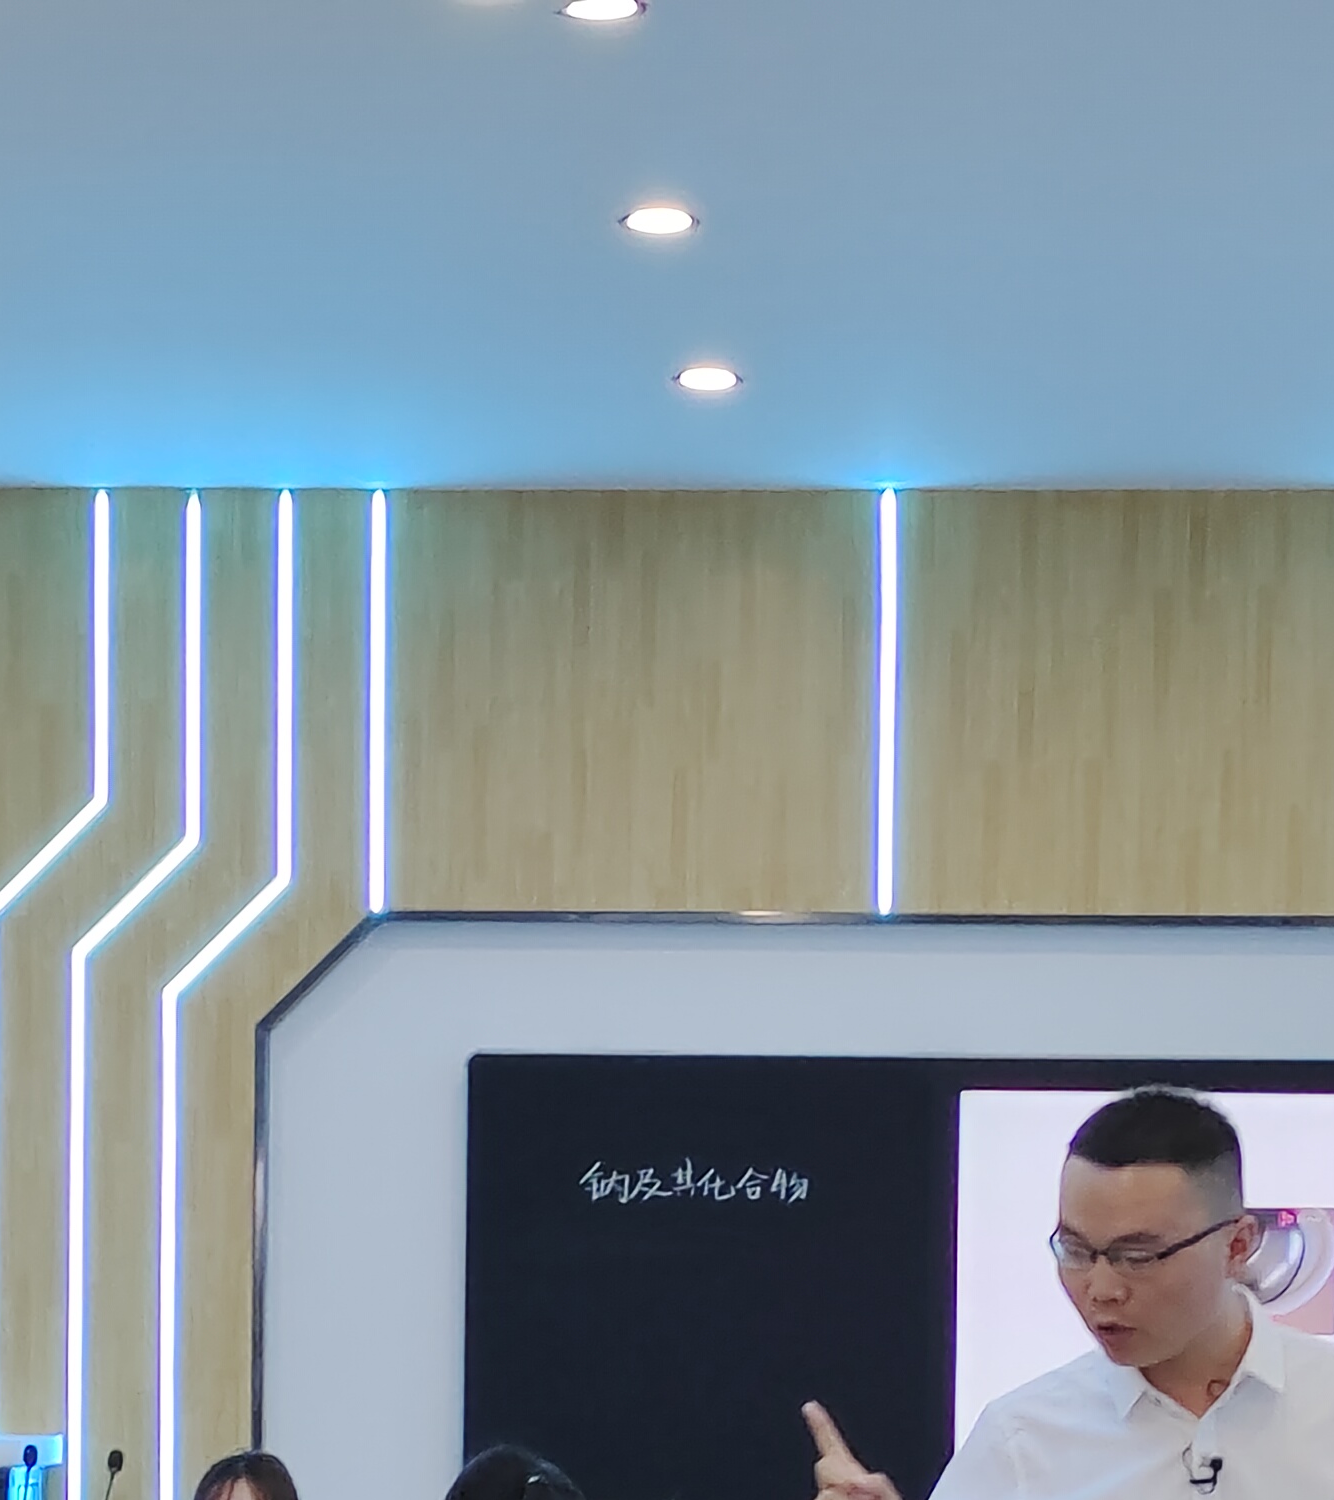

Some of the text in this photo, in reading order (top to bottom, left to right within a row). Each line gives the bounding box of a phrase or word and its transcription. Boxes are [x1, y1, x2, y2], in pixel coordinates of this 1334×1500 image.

[579, 1157, 809, 1204] 钠及其化合物
